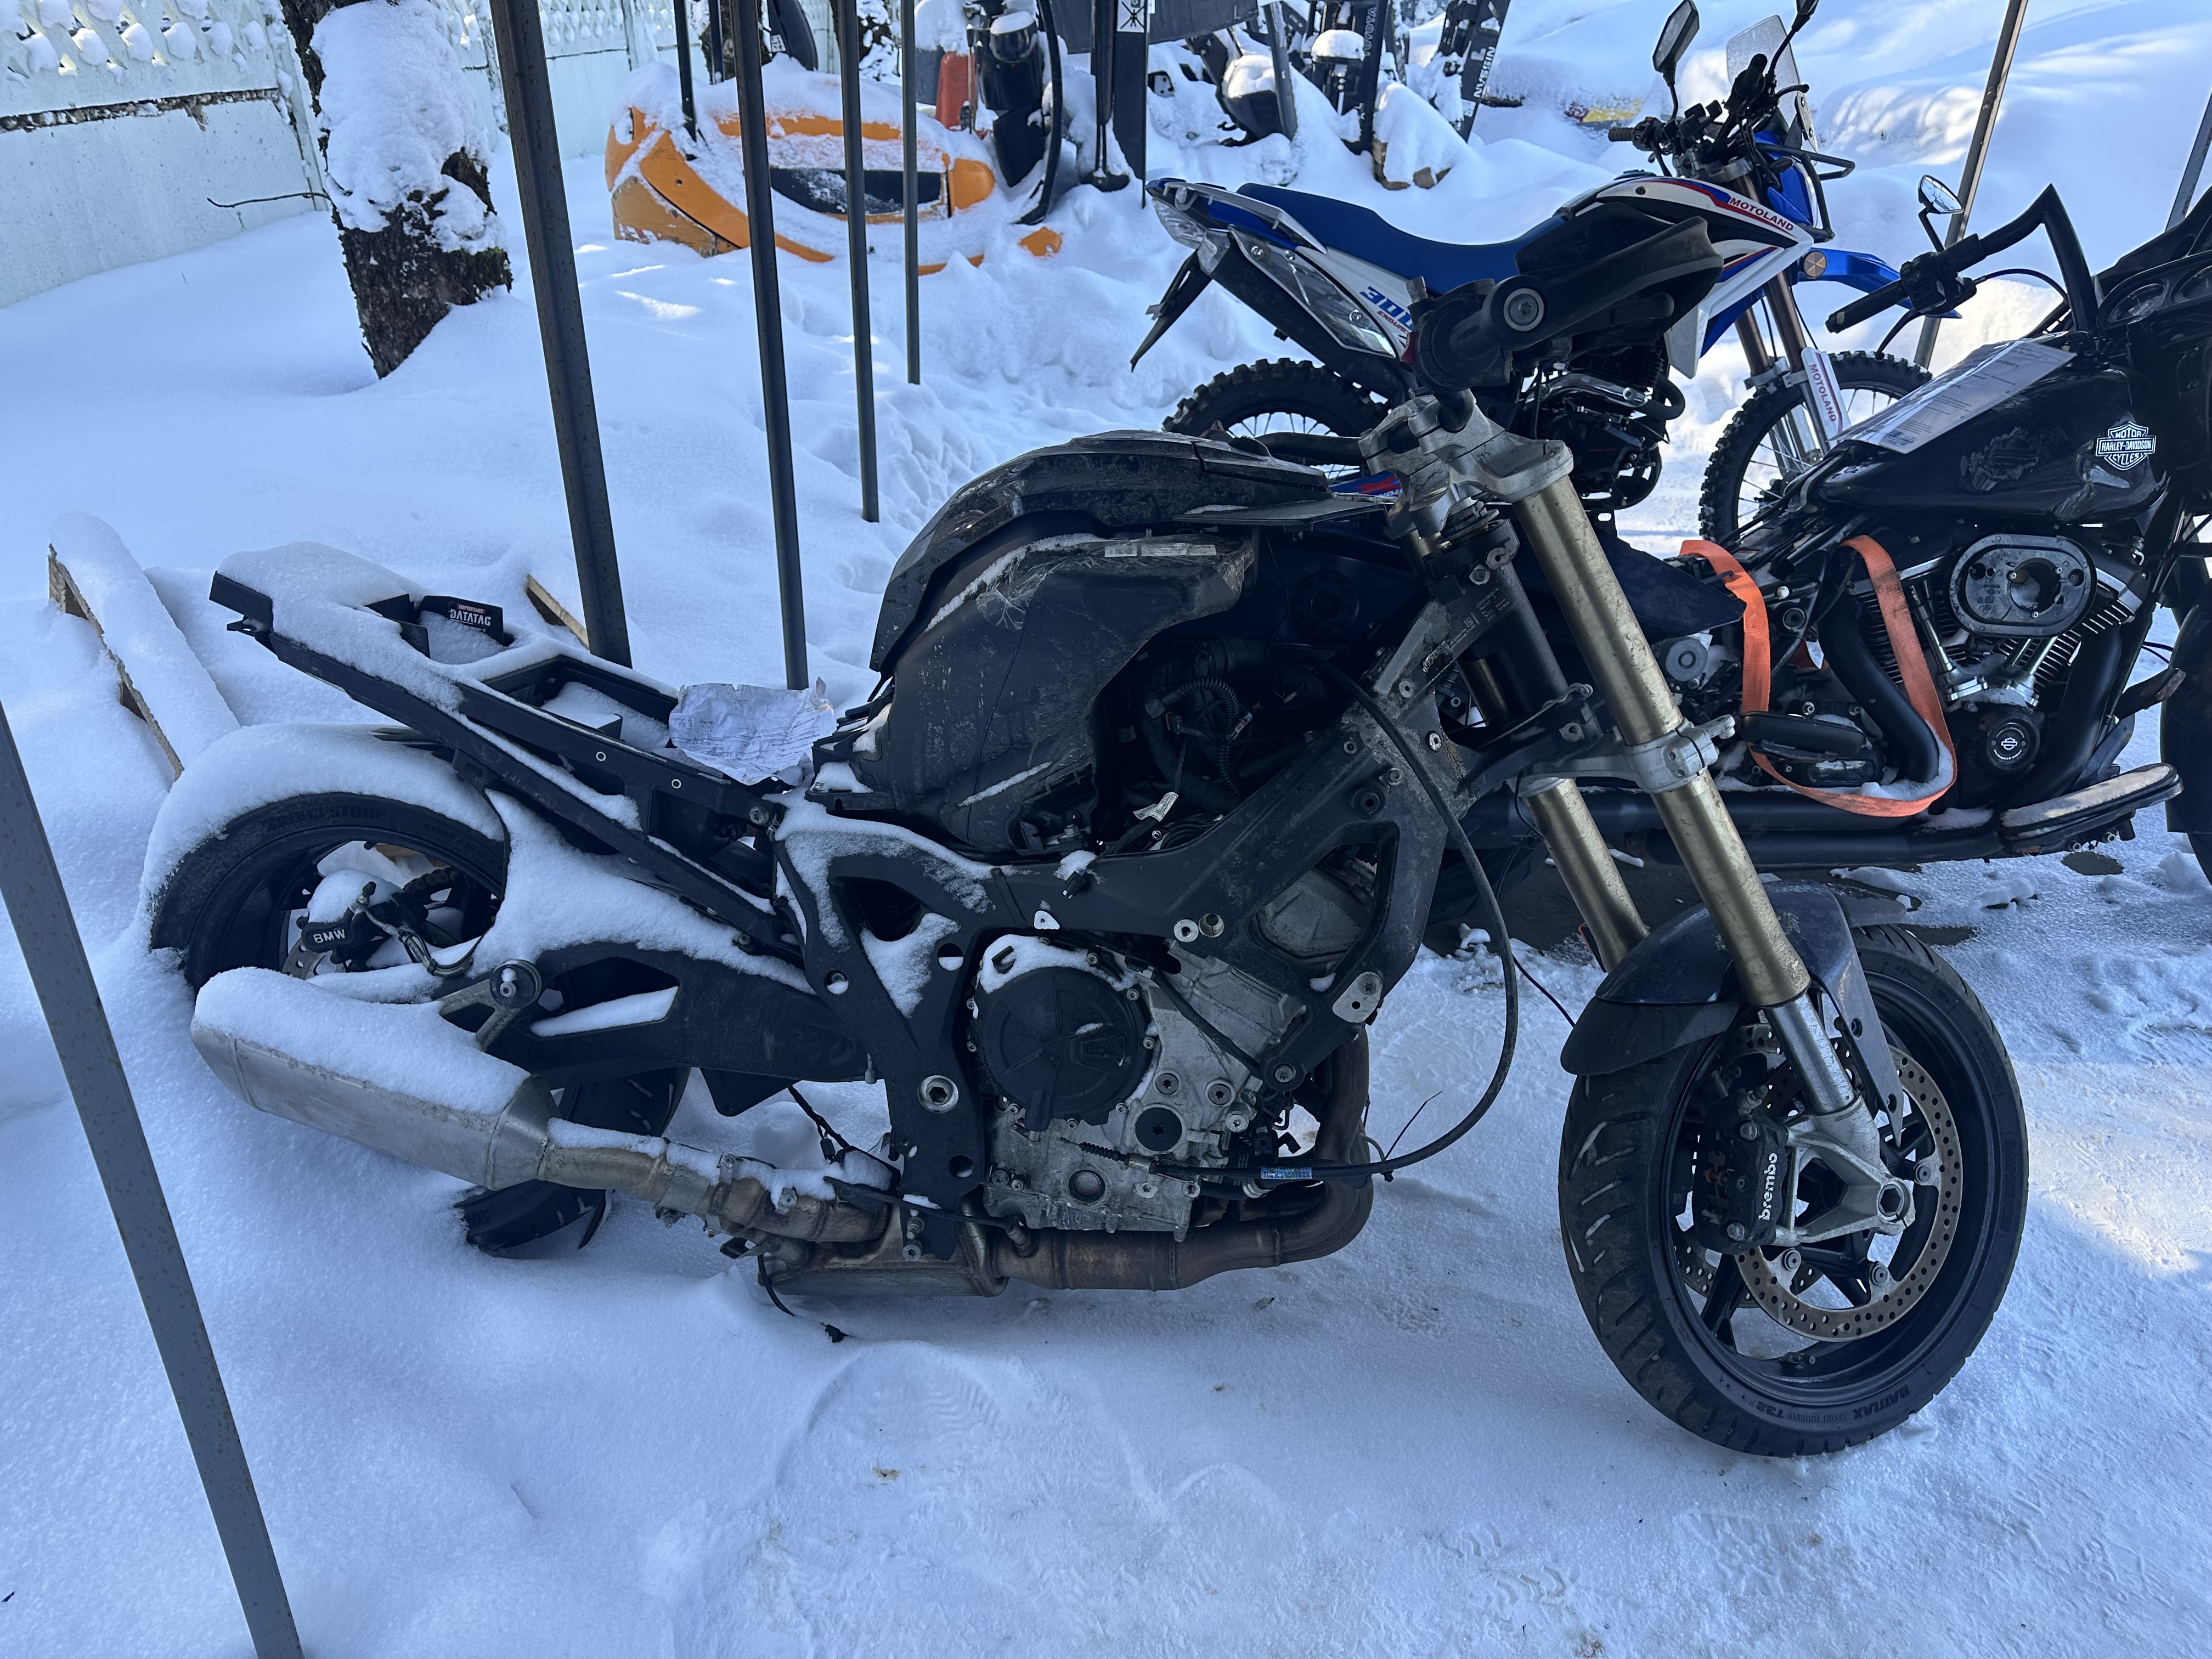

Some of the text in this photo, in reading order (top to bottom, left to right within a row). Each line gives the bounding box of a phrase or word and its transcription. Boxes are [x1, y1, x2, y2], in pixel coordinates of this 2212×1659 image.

[1363, 7, 1377, 57] TOYOTA
[1473, 46, 1495, 98] NISSAN
[1729, 198, 1794, 231] MOTOLAND
[1809, 364, 1837, 422] MOTOLAND
[2115, 427, 2142, 438] MOTOR
[2101, 440, 2152, 452] HARLEY-DAVIDSON
[2112, 453, 2140, 466] CYCLES
[448, 609, 491, 627] DATATAG
[458, 605, 484, 614] IMPORTANT
[261, 805, 387, 833] BRIDGESTONE
[313, 929, 345, 944] BMW
[1758, 1153, 1778, 1220] brembo
[1853, 1385, 1911, 1420] BATTLAX
[1787, 1412, 1821, 1423] TOURING
